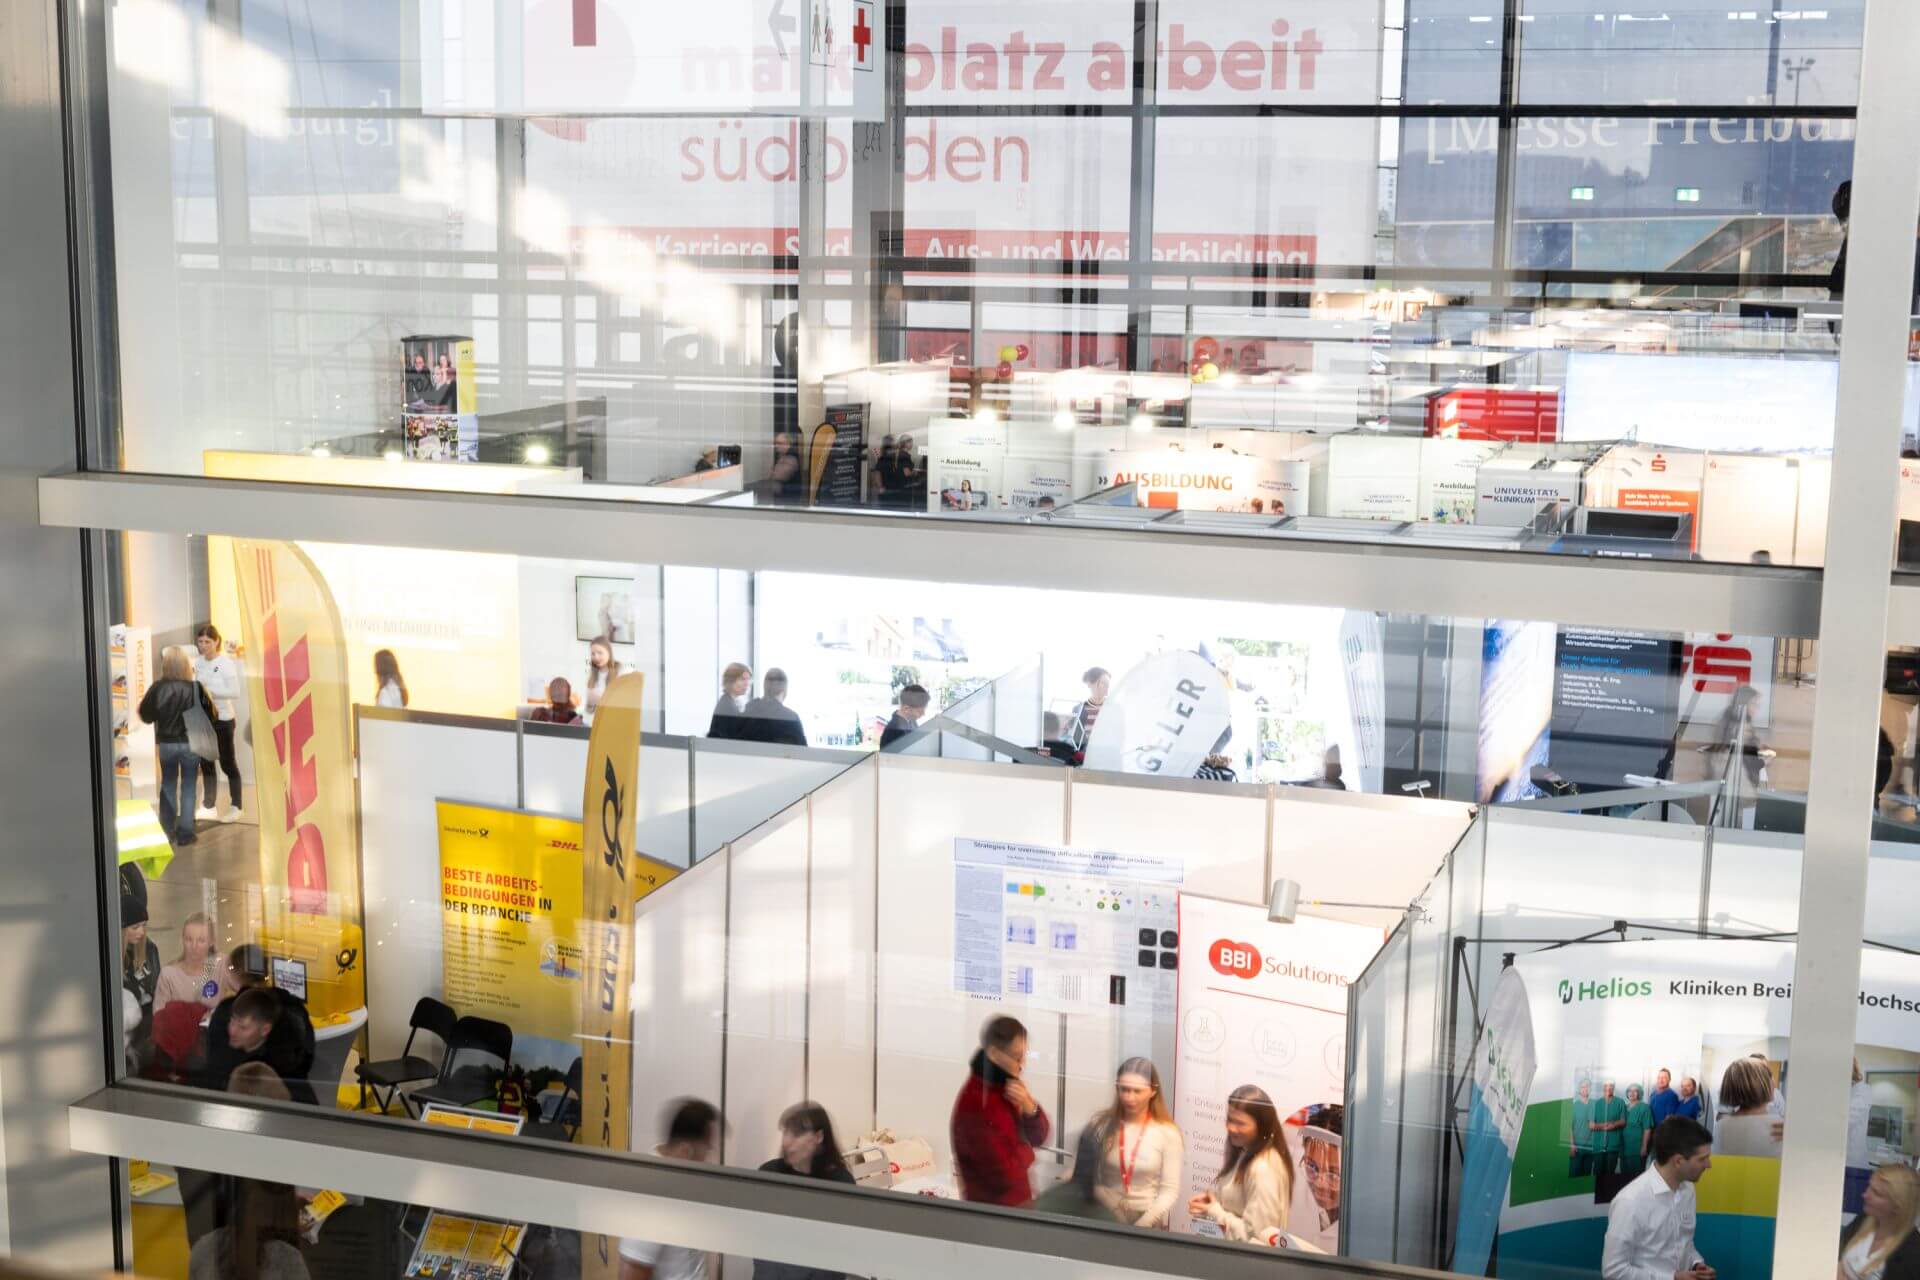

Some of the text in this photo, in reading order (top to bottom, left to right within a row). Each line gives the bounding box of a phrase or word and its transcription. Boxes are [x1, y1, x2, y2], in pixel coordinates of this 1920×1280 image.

[1087, 18, 1323, 92] abeit
[1113, 471, 1233, 491] AUSBILDUNG
[1494, 495, 1536, 504] KLINIKUM
[444, 865, 544, 892] BESTE ARBEITS-
[444, 882, 553, 912] BEDINGUNGEN IN
[444, 898, 533, 924] DER BRANCHE
[1219, 947, 1351, 989] BBI Solutions
[1578, 977, 1653, 1002] Helios
[1669, 980, 1748, 997] Kliniken
